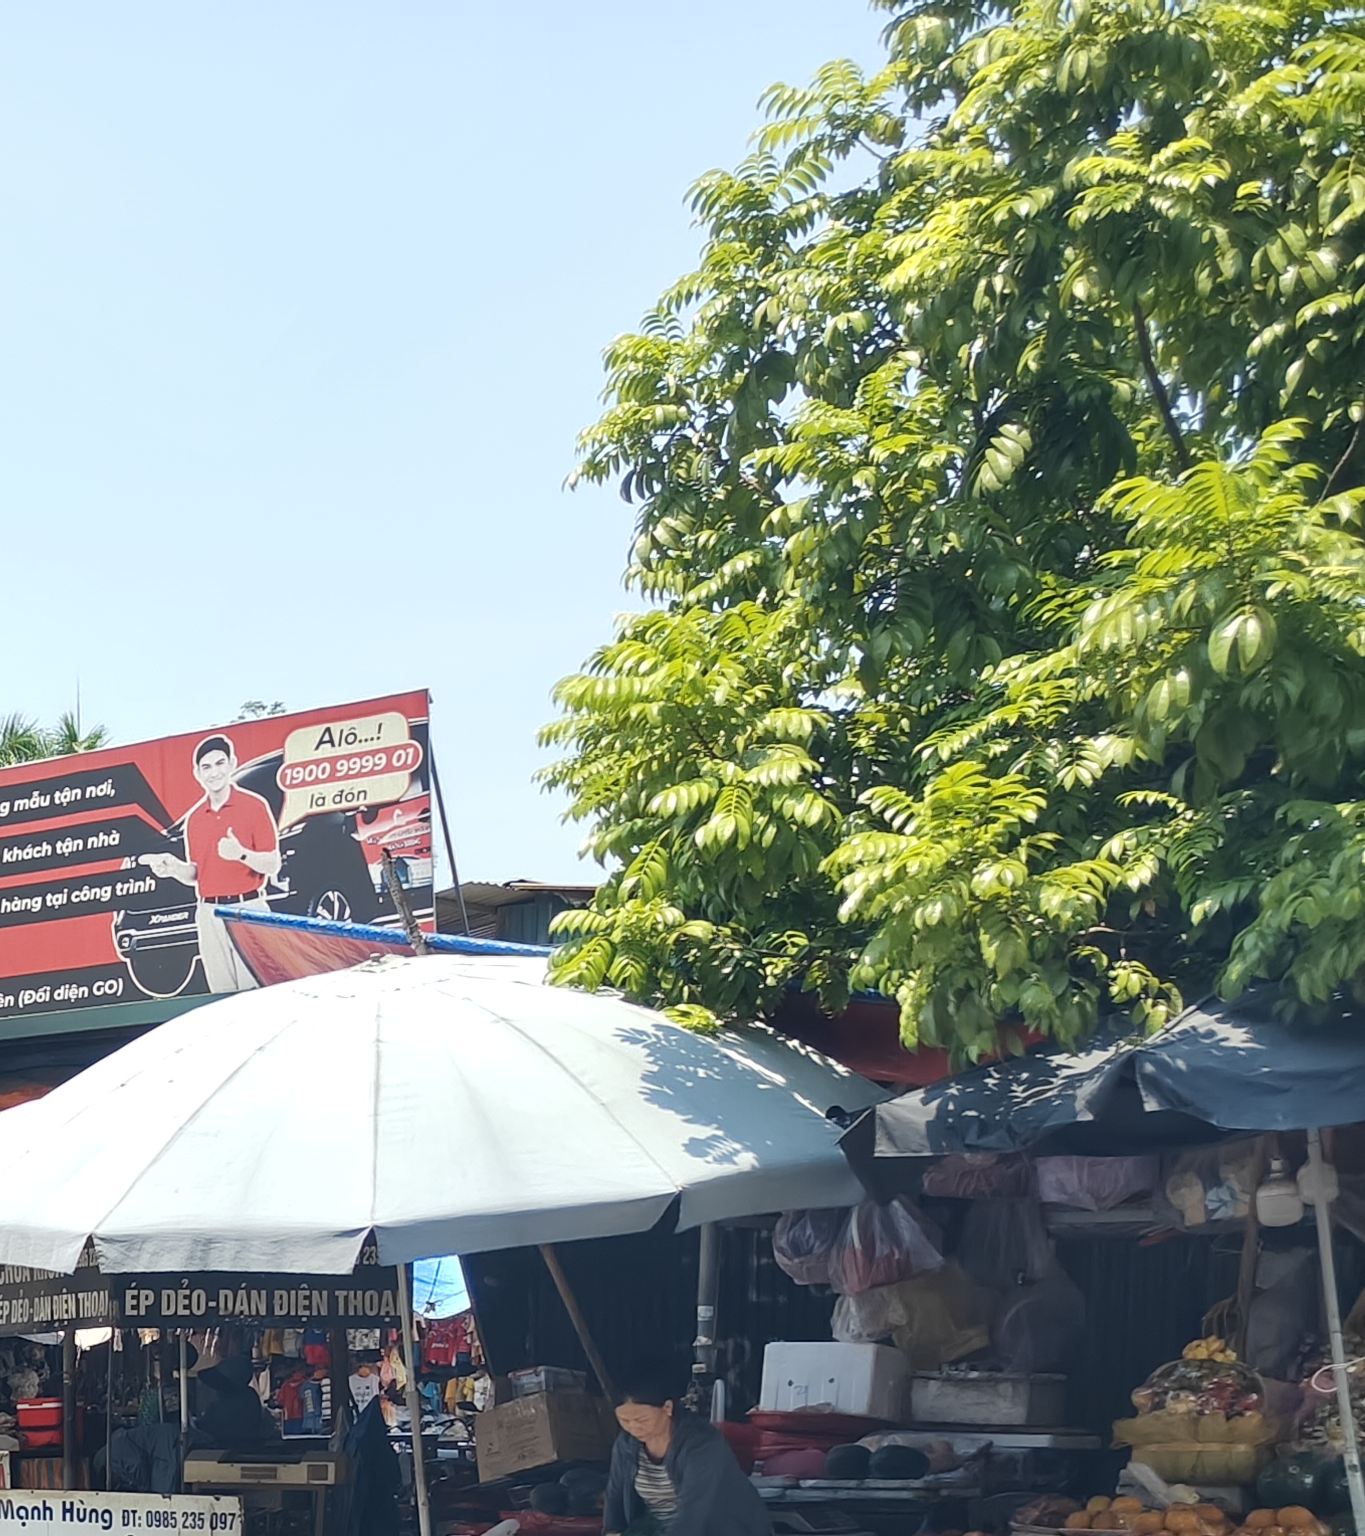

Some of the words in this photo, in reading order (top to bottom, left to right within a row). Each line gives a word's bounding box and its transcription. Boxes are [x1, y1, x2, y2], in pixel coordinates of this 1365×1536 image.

[284, 762, 331, 786] 1900
[335, 752, 387, 777] 9999
[391, 748, 415, 767] 01
[13, 791, 51, 812] mẫu
[53, 786, 82, 809] tận
[85, 779, 116, 797] nơi,
[309, 792, 326, 809] là
[331, 787, 368, 805] đón
[2, 840, 52, 862] khách
[54, 836, 84, 857] tận
[87, 830, 120, 848] nhà
[0, 892, 42, 915] hàng
[45, 889, 68, 909] tại
[71, 883, 112, 903] công
[115, 877, 156, 896] trình
[18, 985, 51, 1010] (Đối
[53, 983, 87, 1004] diện
[92, 977, 124, 998] GO)
[53, 1288, 76, 1322] ĐIỆN
[78, 1290, 108, 1322] THOẠI
[124, 1283, 155, 1316] ÉP
[273, 1283, 327, 1323] ĐIỆN
[62, 1500, 113, 1530] Hùng
[121, 1510, 142, 1527] ĐT:
[146, 1510, 177, 1529] 0985
[181, 1511, 205, 1529] 235
[210, 1512, 236, 1530] 097
